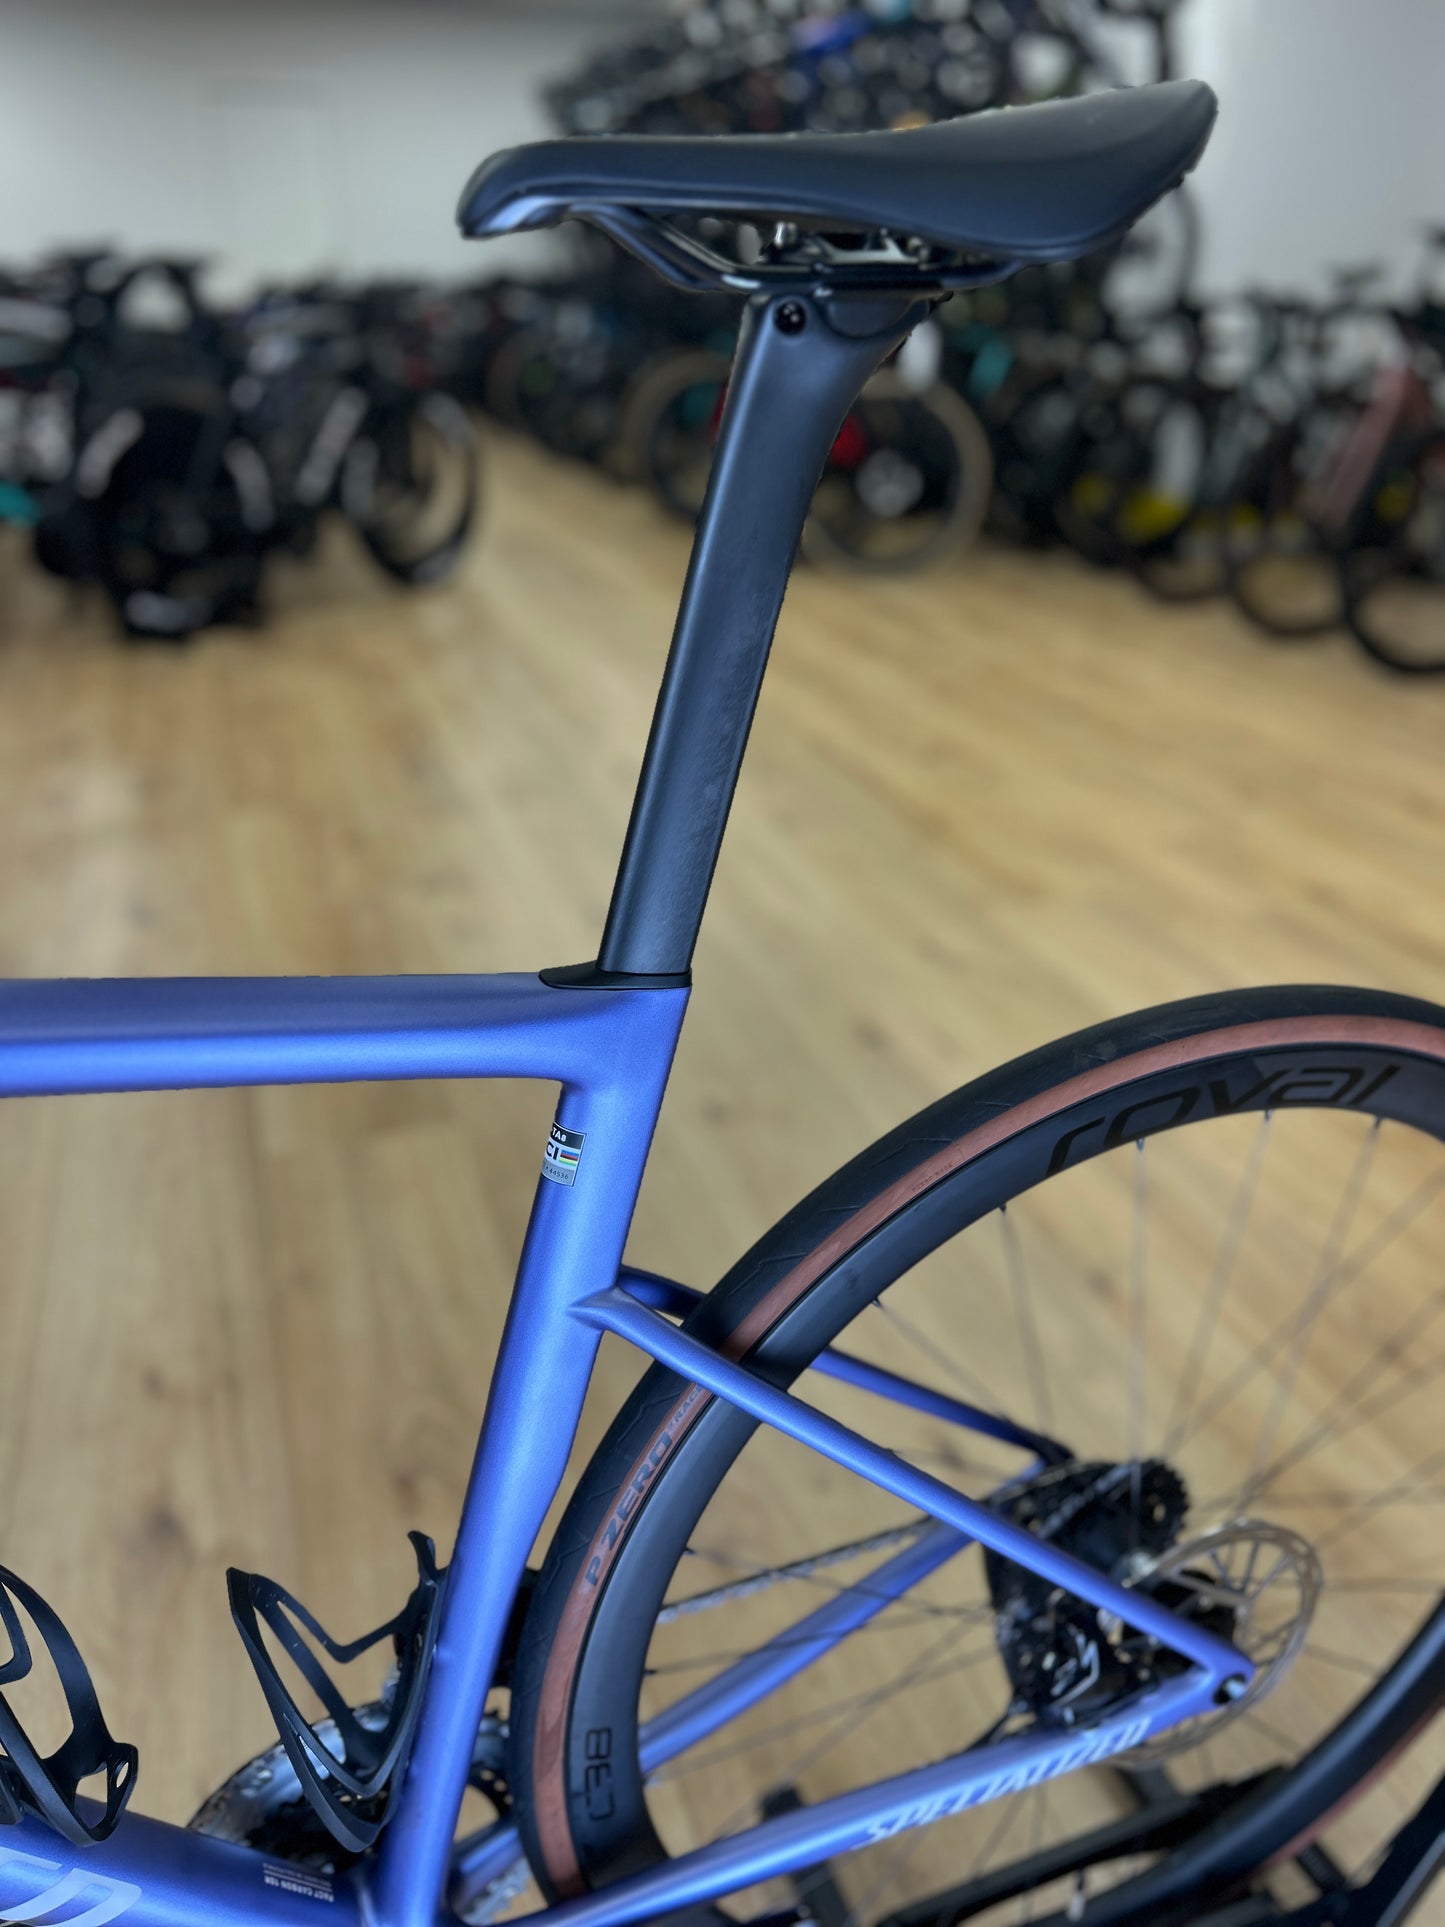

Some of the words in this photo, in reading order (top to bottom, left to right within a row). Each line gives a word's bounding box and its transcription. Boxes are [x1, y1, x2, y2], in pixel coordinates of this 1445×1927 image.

[585, 1555, 602, 1587] P
[601, 1430, 673, 1551] ZERO
[584, 1727, 615, 1822] C38
